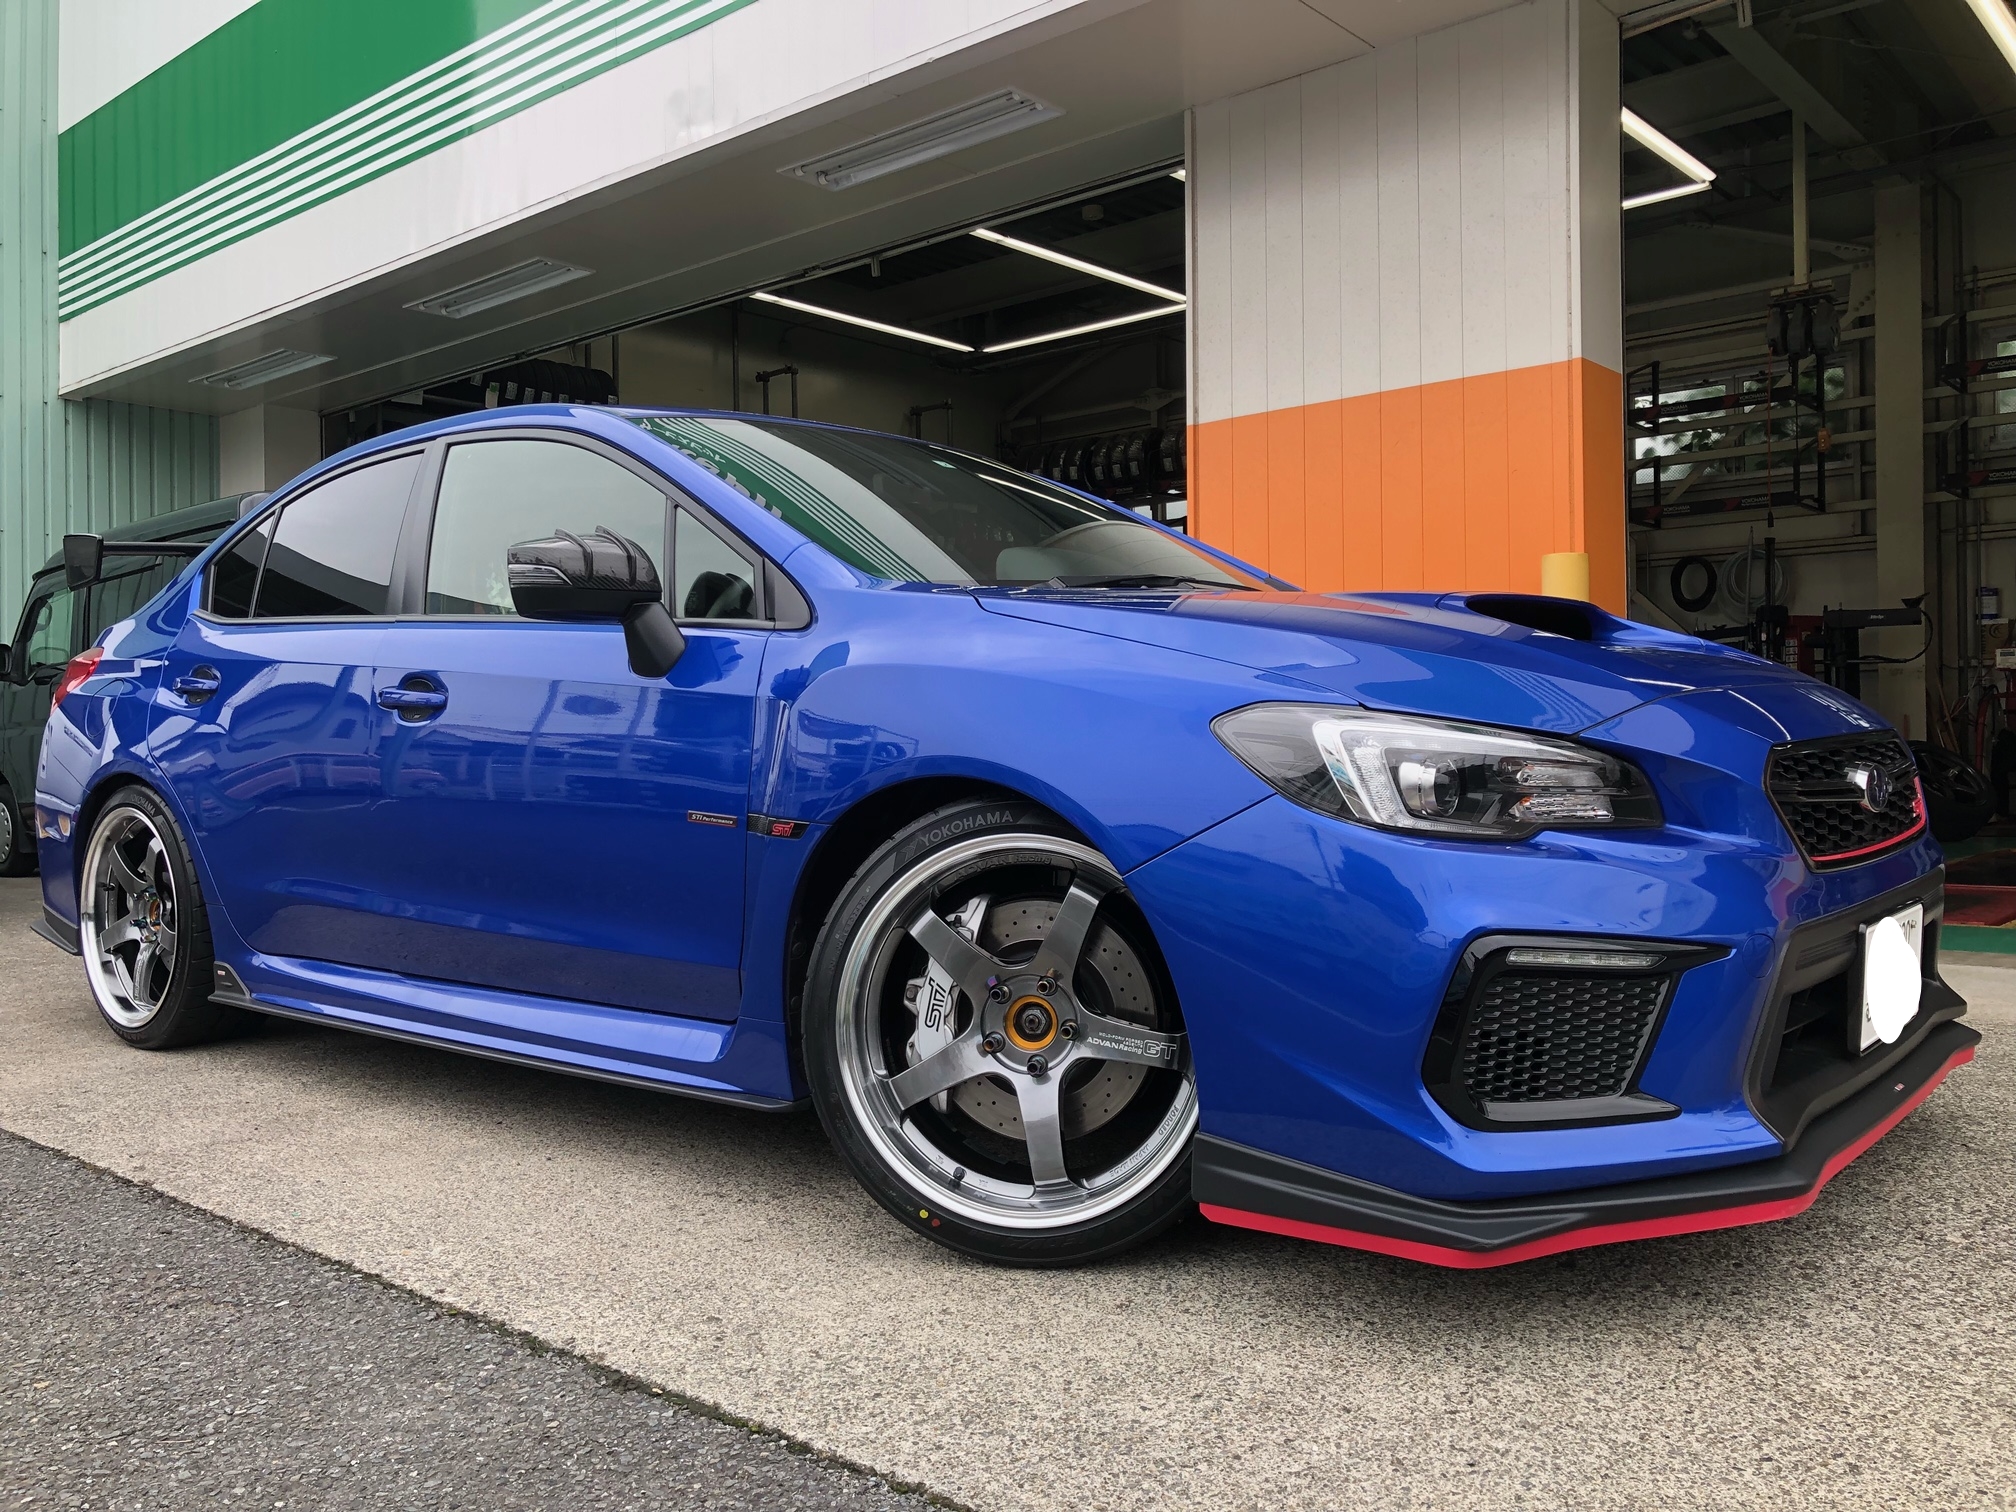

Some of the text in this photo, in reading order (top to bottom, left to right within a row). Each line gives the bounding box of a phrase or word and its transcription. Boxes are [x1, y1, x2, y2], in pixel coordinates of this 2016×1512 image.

[703, 816, 734, 825] Performance
[919, 810, 1014, 847] YOKOHAMA
[1086, 1036, 1119, 1049] ADVAN
[1118, 1043, 1143, 1055] Racing
[1143, 1040, 1177, 1060] GT
